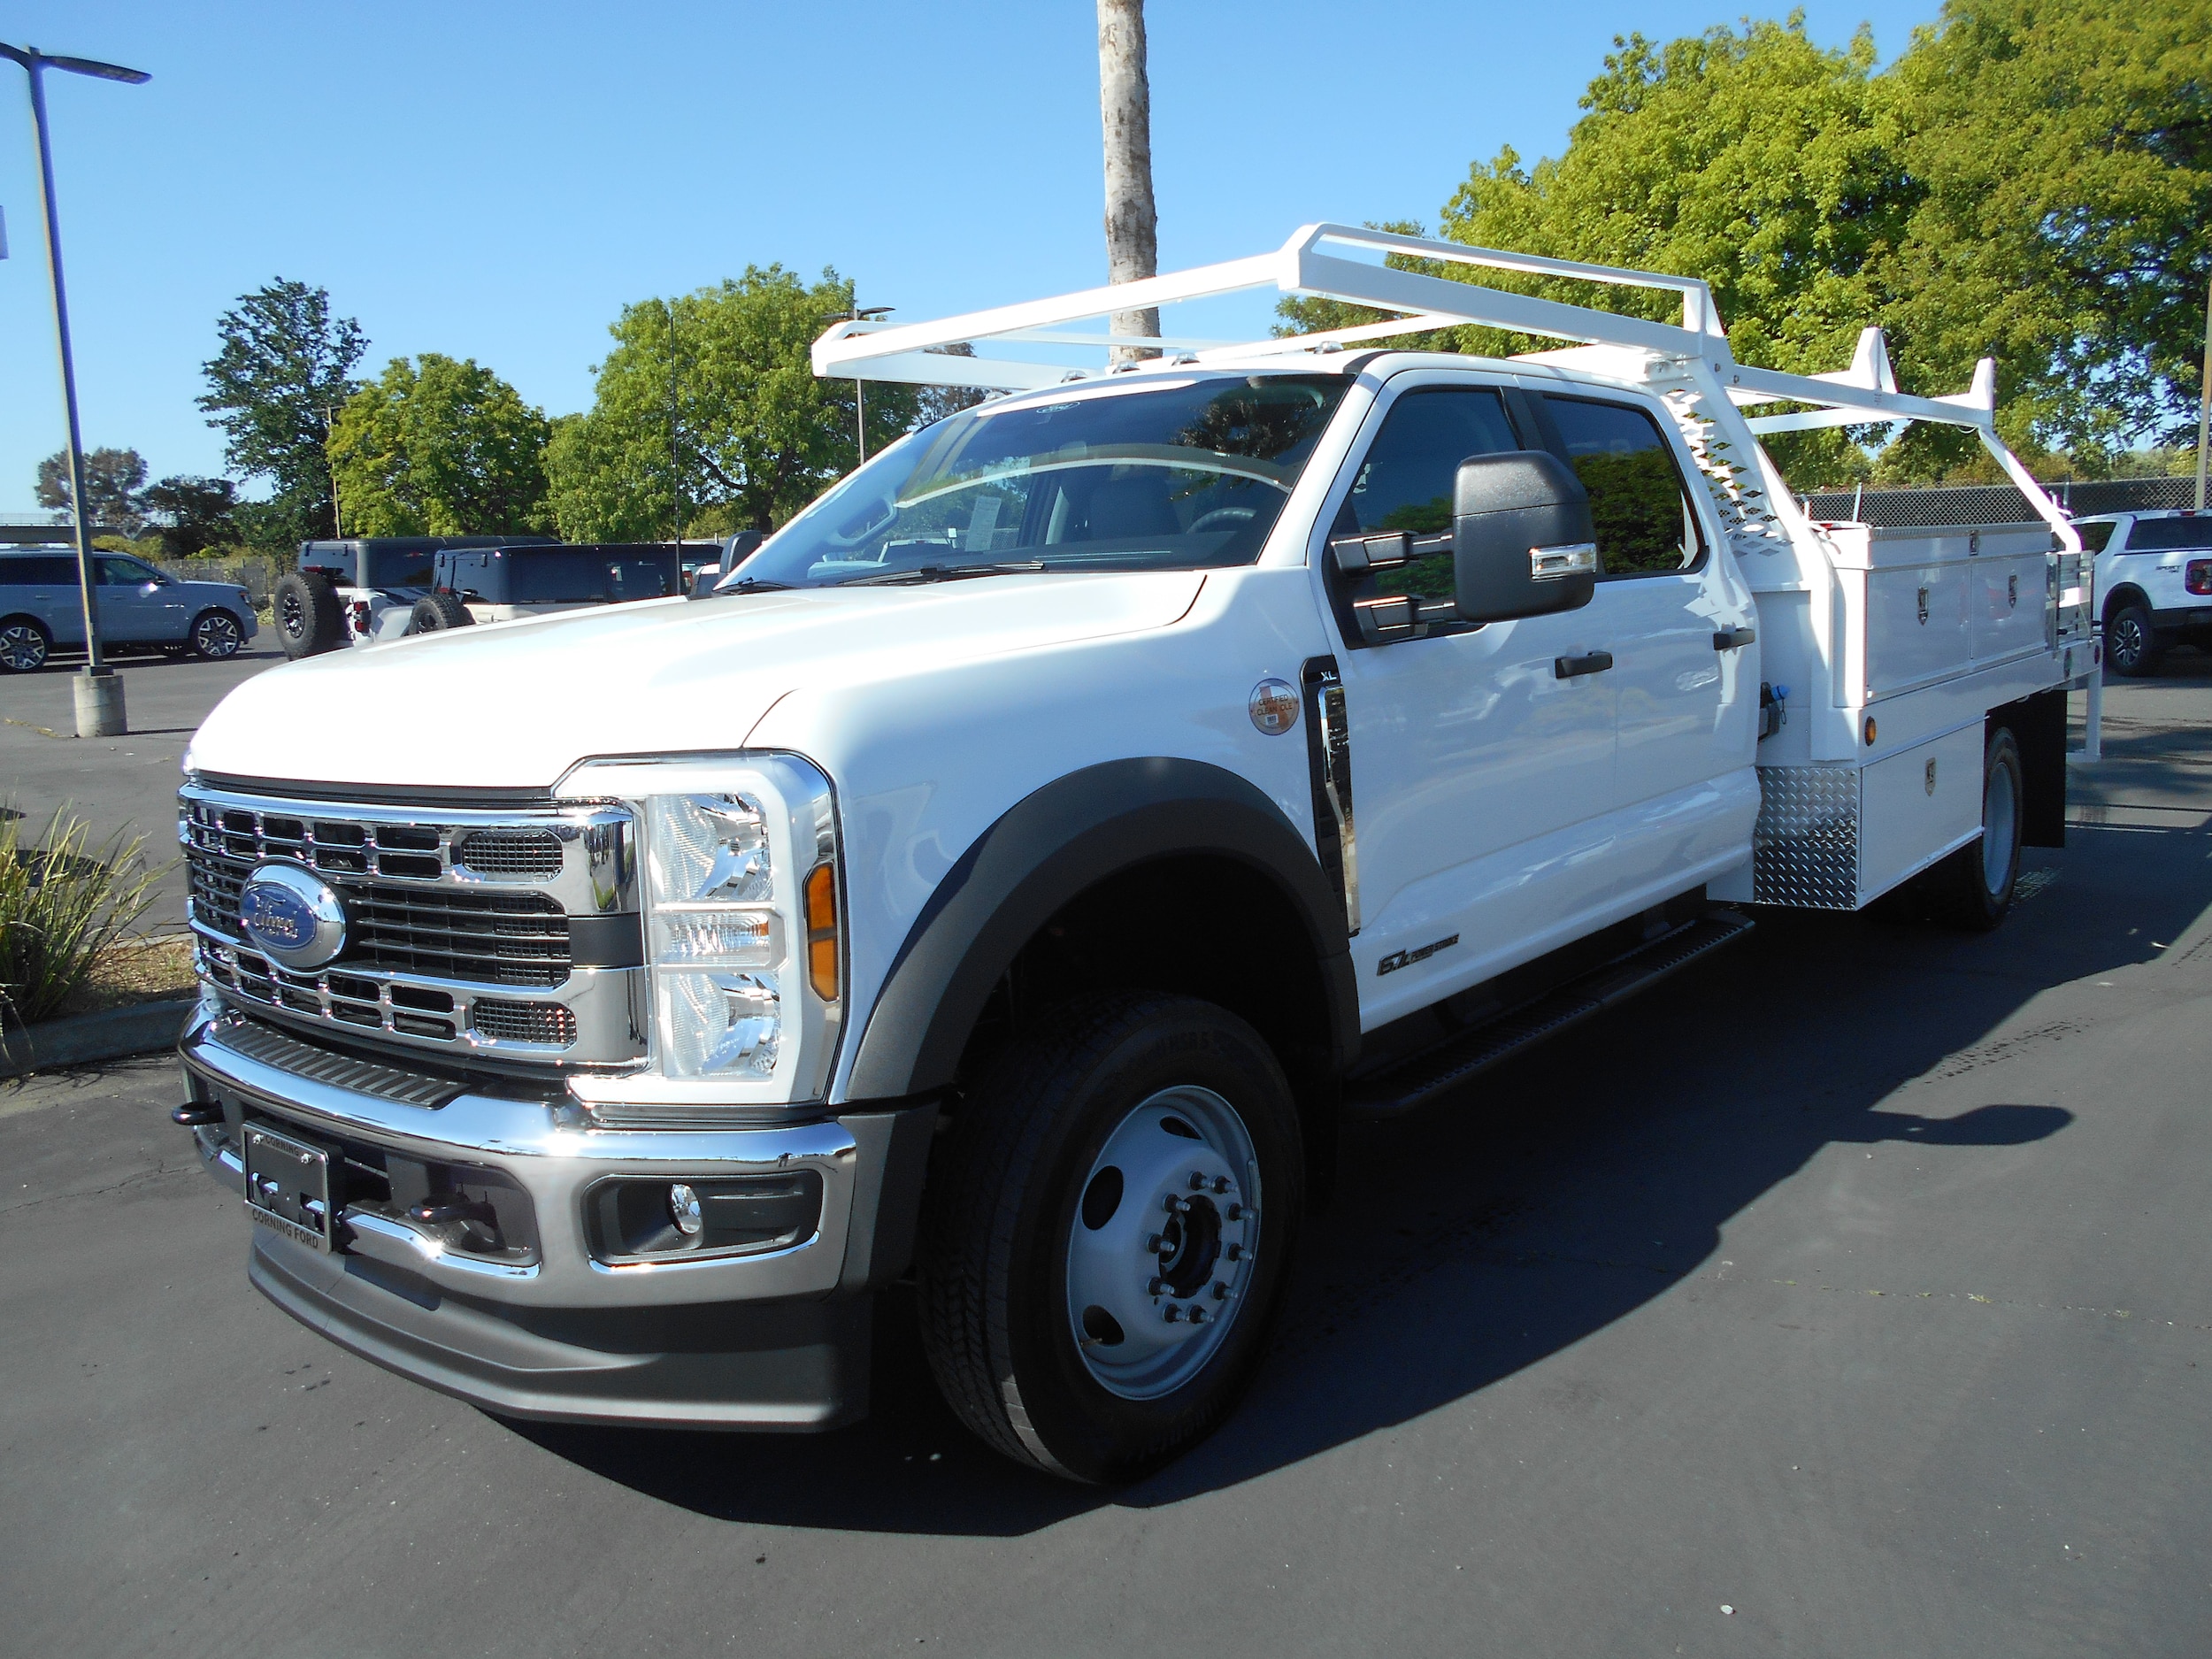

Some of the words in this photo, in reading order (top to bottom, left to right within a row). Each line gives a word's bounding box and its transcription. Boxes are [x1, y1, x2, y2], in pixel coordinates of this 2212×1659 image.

[1320, 671, 1337, 681] XL
[251, 893, 298, 940] Ford
[265, 1134, 299, 1156] CORNING
[251, 1209, 292, 1236] CORNING
[294, 1230, 319, 1249] FORD
